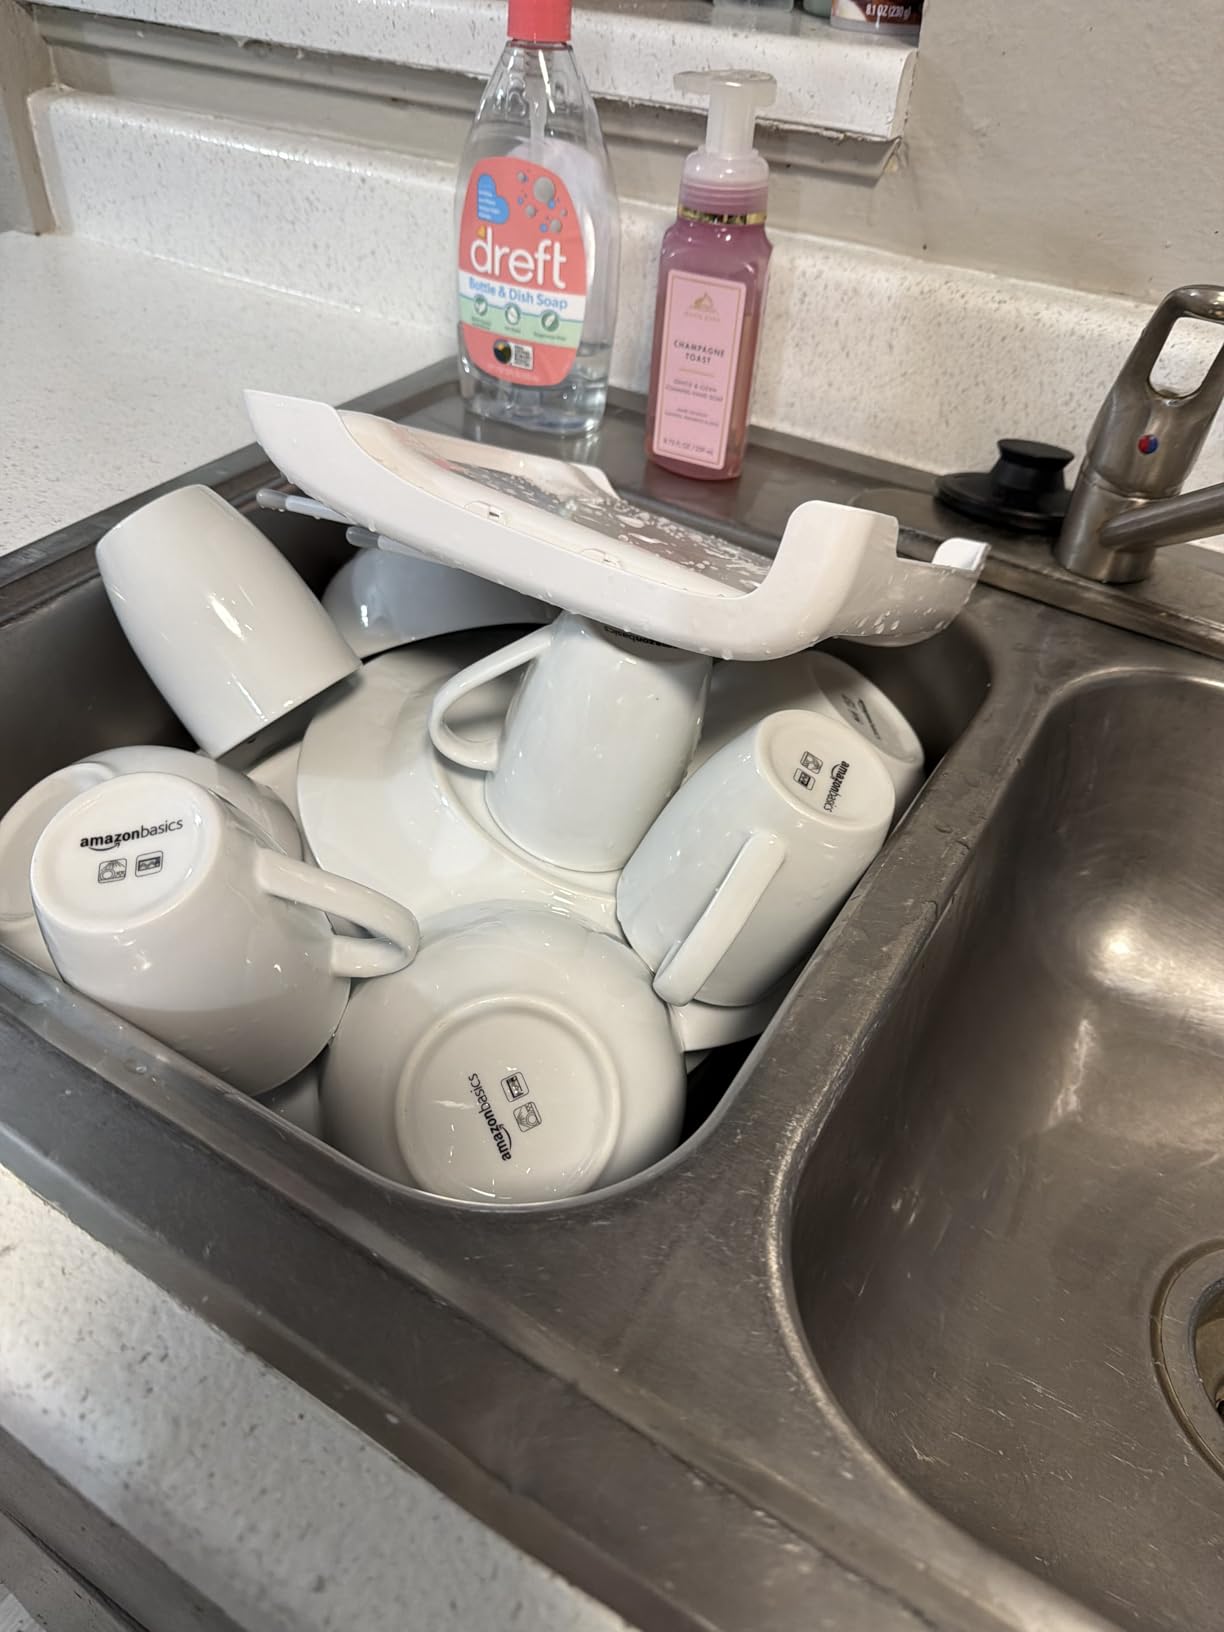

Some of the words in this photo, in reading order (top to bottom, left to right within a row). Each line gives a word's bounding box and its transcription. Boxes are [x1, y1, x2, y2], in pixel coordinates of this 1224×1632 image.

[866, 3, 876, 16] 8.1
[877, 4, 888, 17] OZ
[470, 226, 567, 289] dreft
[468, 276, 496, 294] Bottle
[498, 286, 506, 298] &
[509, 288, 534, 304] Dish
[536, 293, 568, 310] Soap
[673, 340, 725, 357] CHAMPAGNE
[685, 353, 712, 364] TOAST
[823, 760, 850, 812] amazonbasics
[80, 819, 184, 851] amazonbasics
[468, 1073, 512, 1161] amazonbasics
